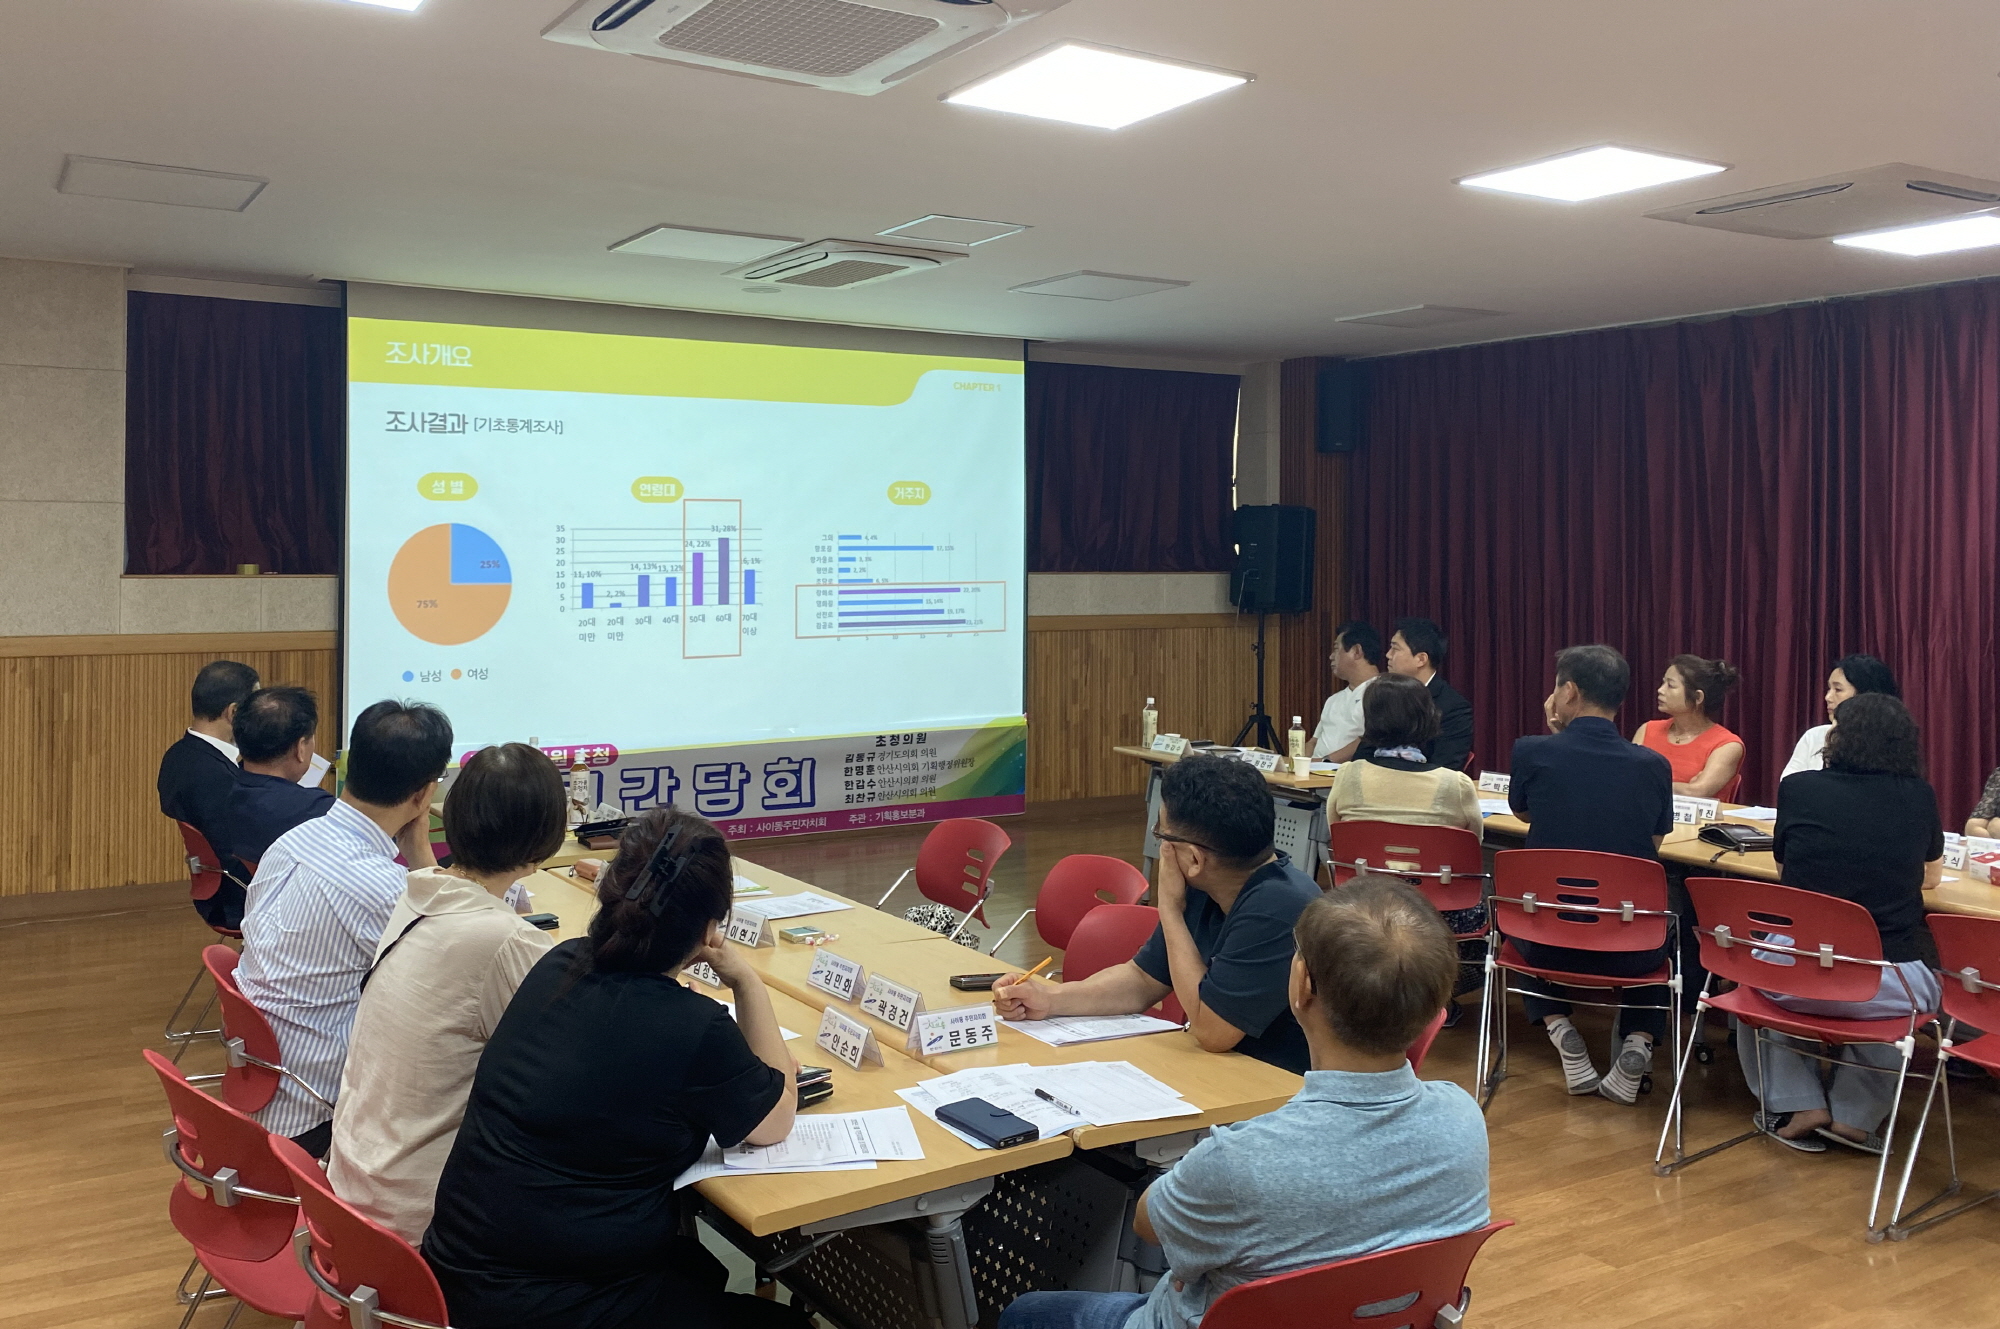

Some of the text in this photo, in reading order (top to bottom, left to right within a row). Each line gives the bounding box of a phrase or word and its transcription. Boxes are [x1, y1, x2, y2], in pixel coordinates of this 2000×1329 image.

[385, 342, 473, 367] 조사개요
[953, 382, 994, 391] CHAPTER
[385, 410, 564, 435] 조사결과 [기초통계조사]
[639, 483, 675, 496] 연령대
[894, 487, 924, 499] 거주지
[556, 536, 565, 544] 30
[697, 540, 711, 548] 22%
[480, 560, 500, 569] 25%
[556, 559, 565, 567] 20
[556, 582, 565, 590] 10
[417, 600, 438, 609] 75%
[579, 617, 596, 627] 20대
[607, 616, 624, 626] 20대
[635, 615, 652, 625] 30대
[663, 614, 679, 624] 40대
[690, 614, 705, 623] 50대
[716, 613, 731, 622] 60대
[742, 612, 757, 622] 70대
[579, 632, 596, 642] 미만
[608, 632, 624, 641] 미만
[742, 627, 757, 636] 이상
[420, 670, 442, 683] 남성
[467, 668, 489, 680] 여성
[876, 733, 927, 747] 초청의원
[845, 748, 937, 763] 김동규 경기도의회 의원
[844, 757, 975, 776] 한명훈 안산시의회 기획행정위원장
[844, 774, 936, 790] 한갑수 안산시의회 의원
[845, 786, 936, 804] 최찬규 안산시의회 의원
[849, 812, 866, 823] 주관
[875, 808, 925, 822] 기획홍보분과
[728, 824, 746, 836] 주최
[756, 817, 827, 833] 사이동주민자치회
[730, 926, 758, 945] 이현지
[825, 970, 852, 993] 김민화
[878, 1000, 908, 1026] 곽경건
[949, 1025, 993, 1047] 문동주
[831, 1034, 859, 1063] 안순희
